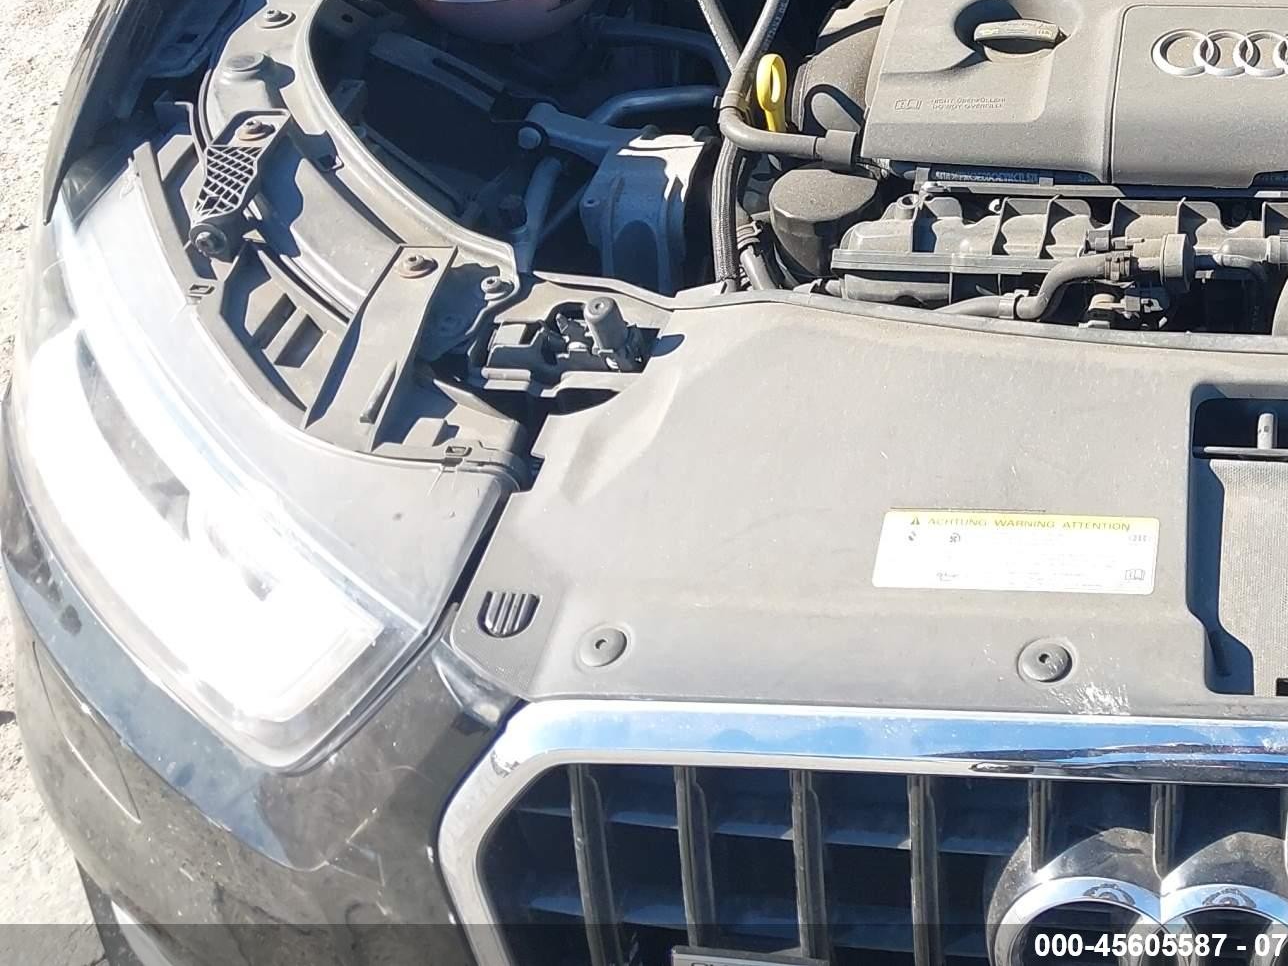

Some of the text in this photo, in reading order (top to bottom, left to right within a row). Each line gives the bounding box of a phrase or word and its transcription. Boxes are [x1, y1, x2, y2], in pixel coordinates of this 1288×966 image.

[928, 518, 1131, 532] ACHTUNG WARNING ATTENTION
